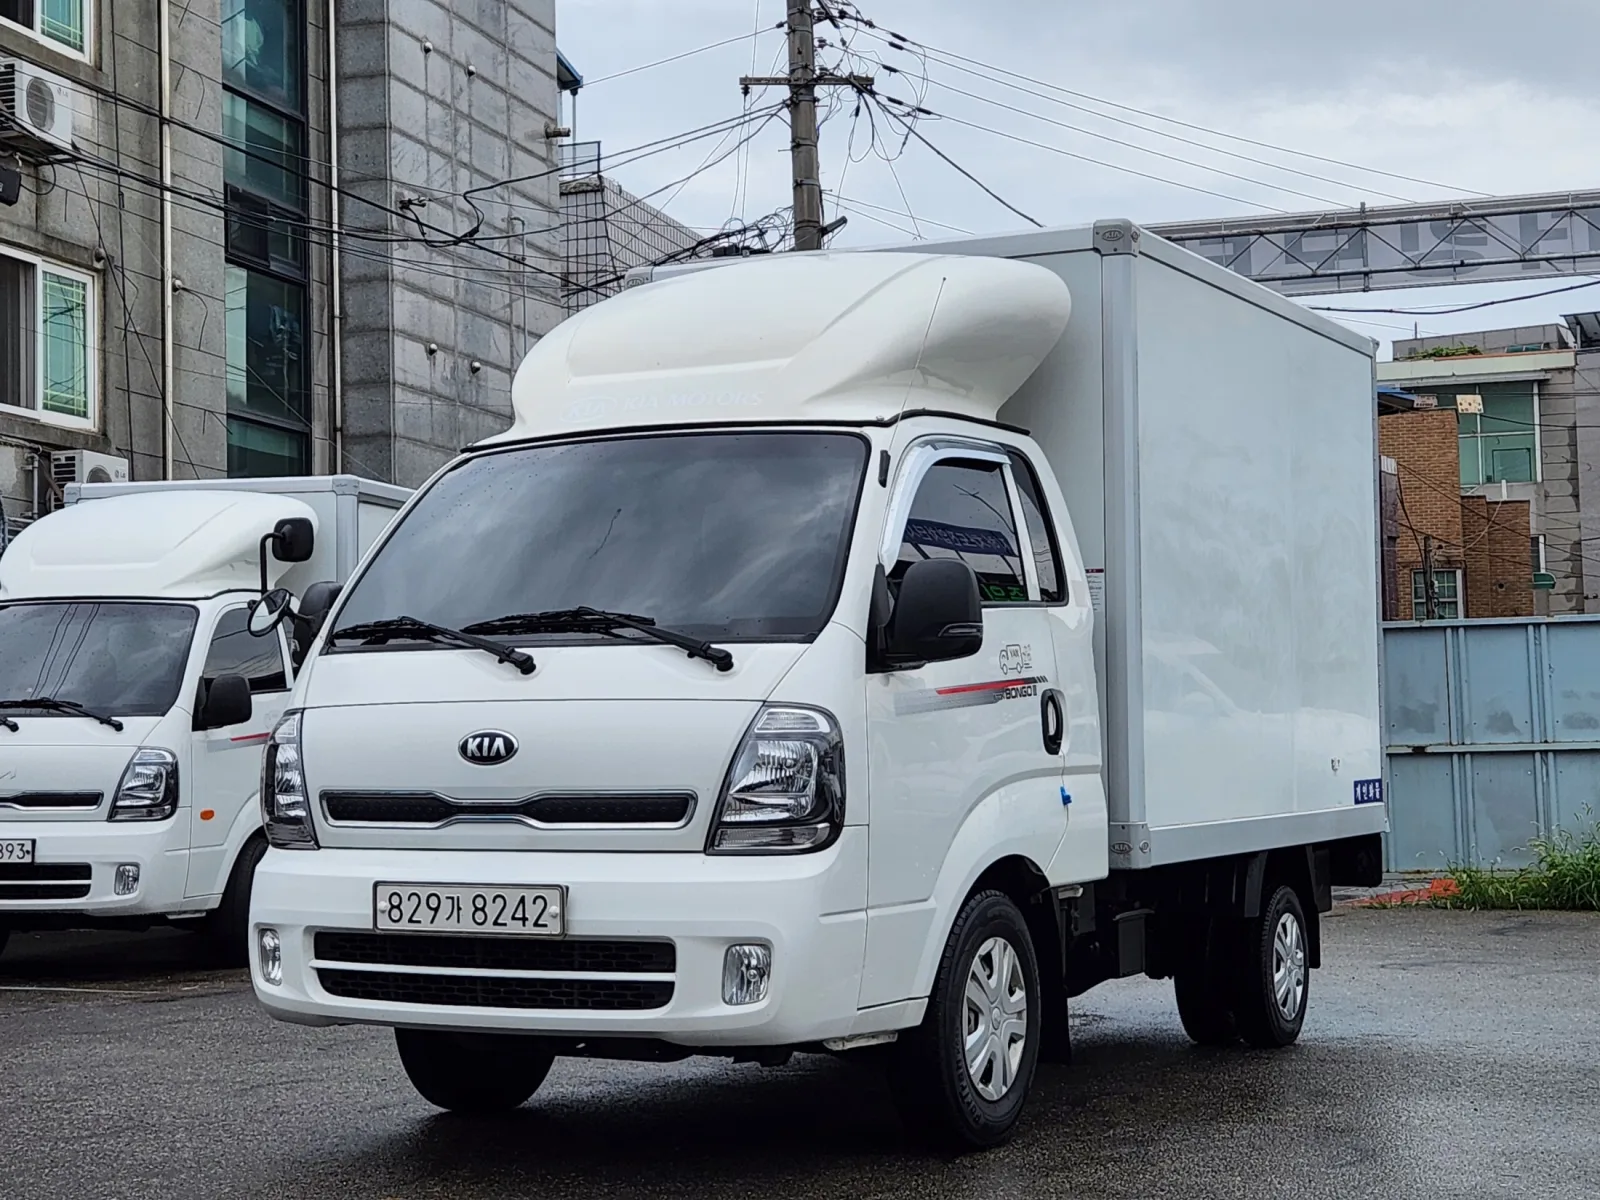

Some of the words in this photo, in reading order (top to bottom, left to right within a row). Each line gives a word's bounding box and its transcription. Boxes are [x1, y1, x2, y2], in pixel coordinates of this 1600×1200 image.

[1005, 685, 1033, 700] BONGO
[466, 736, 507, 757] KIA
[387, 891, 463, 925] 829가
[471, 893, 549, 928] 8242
